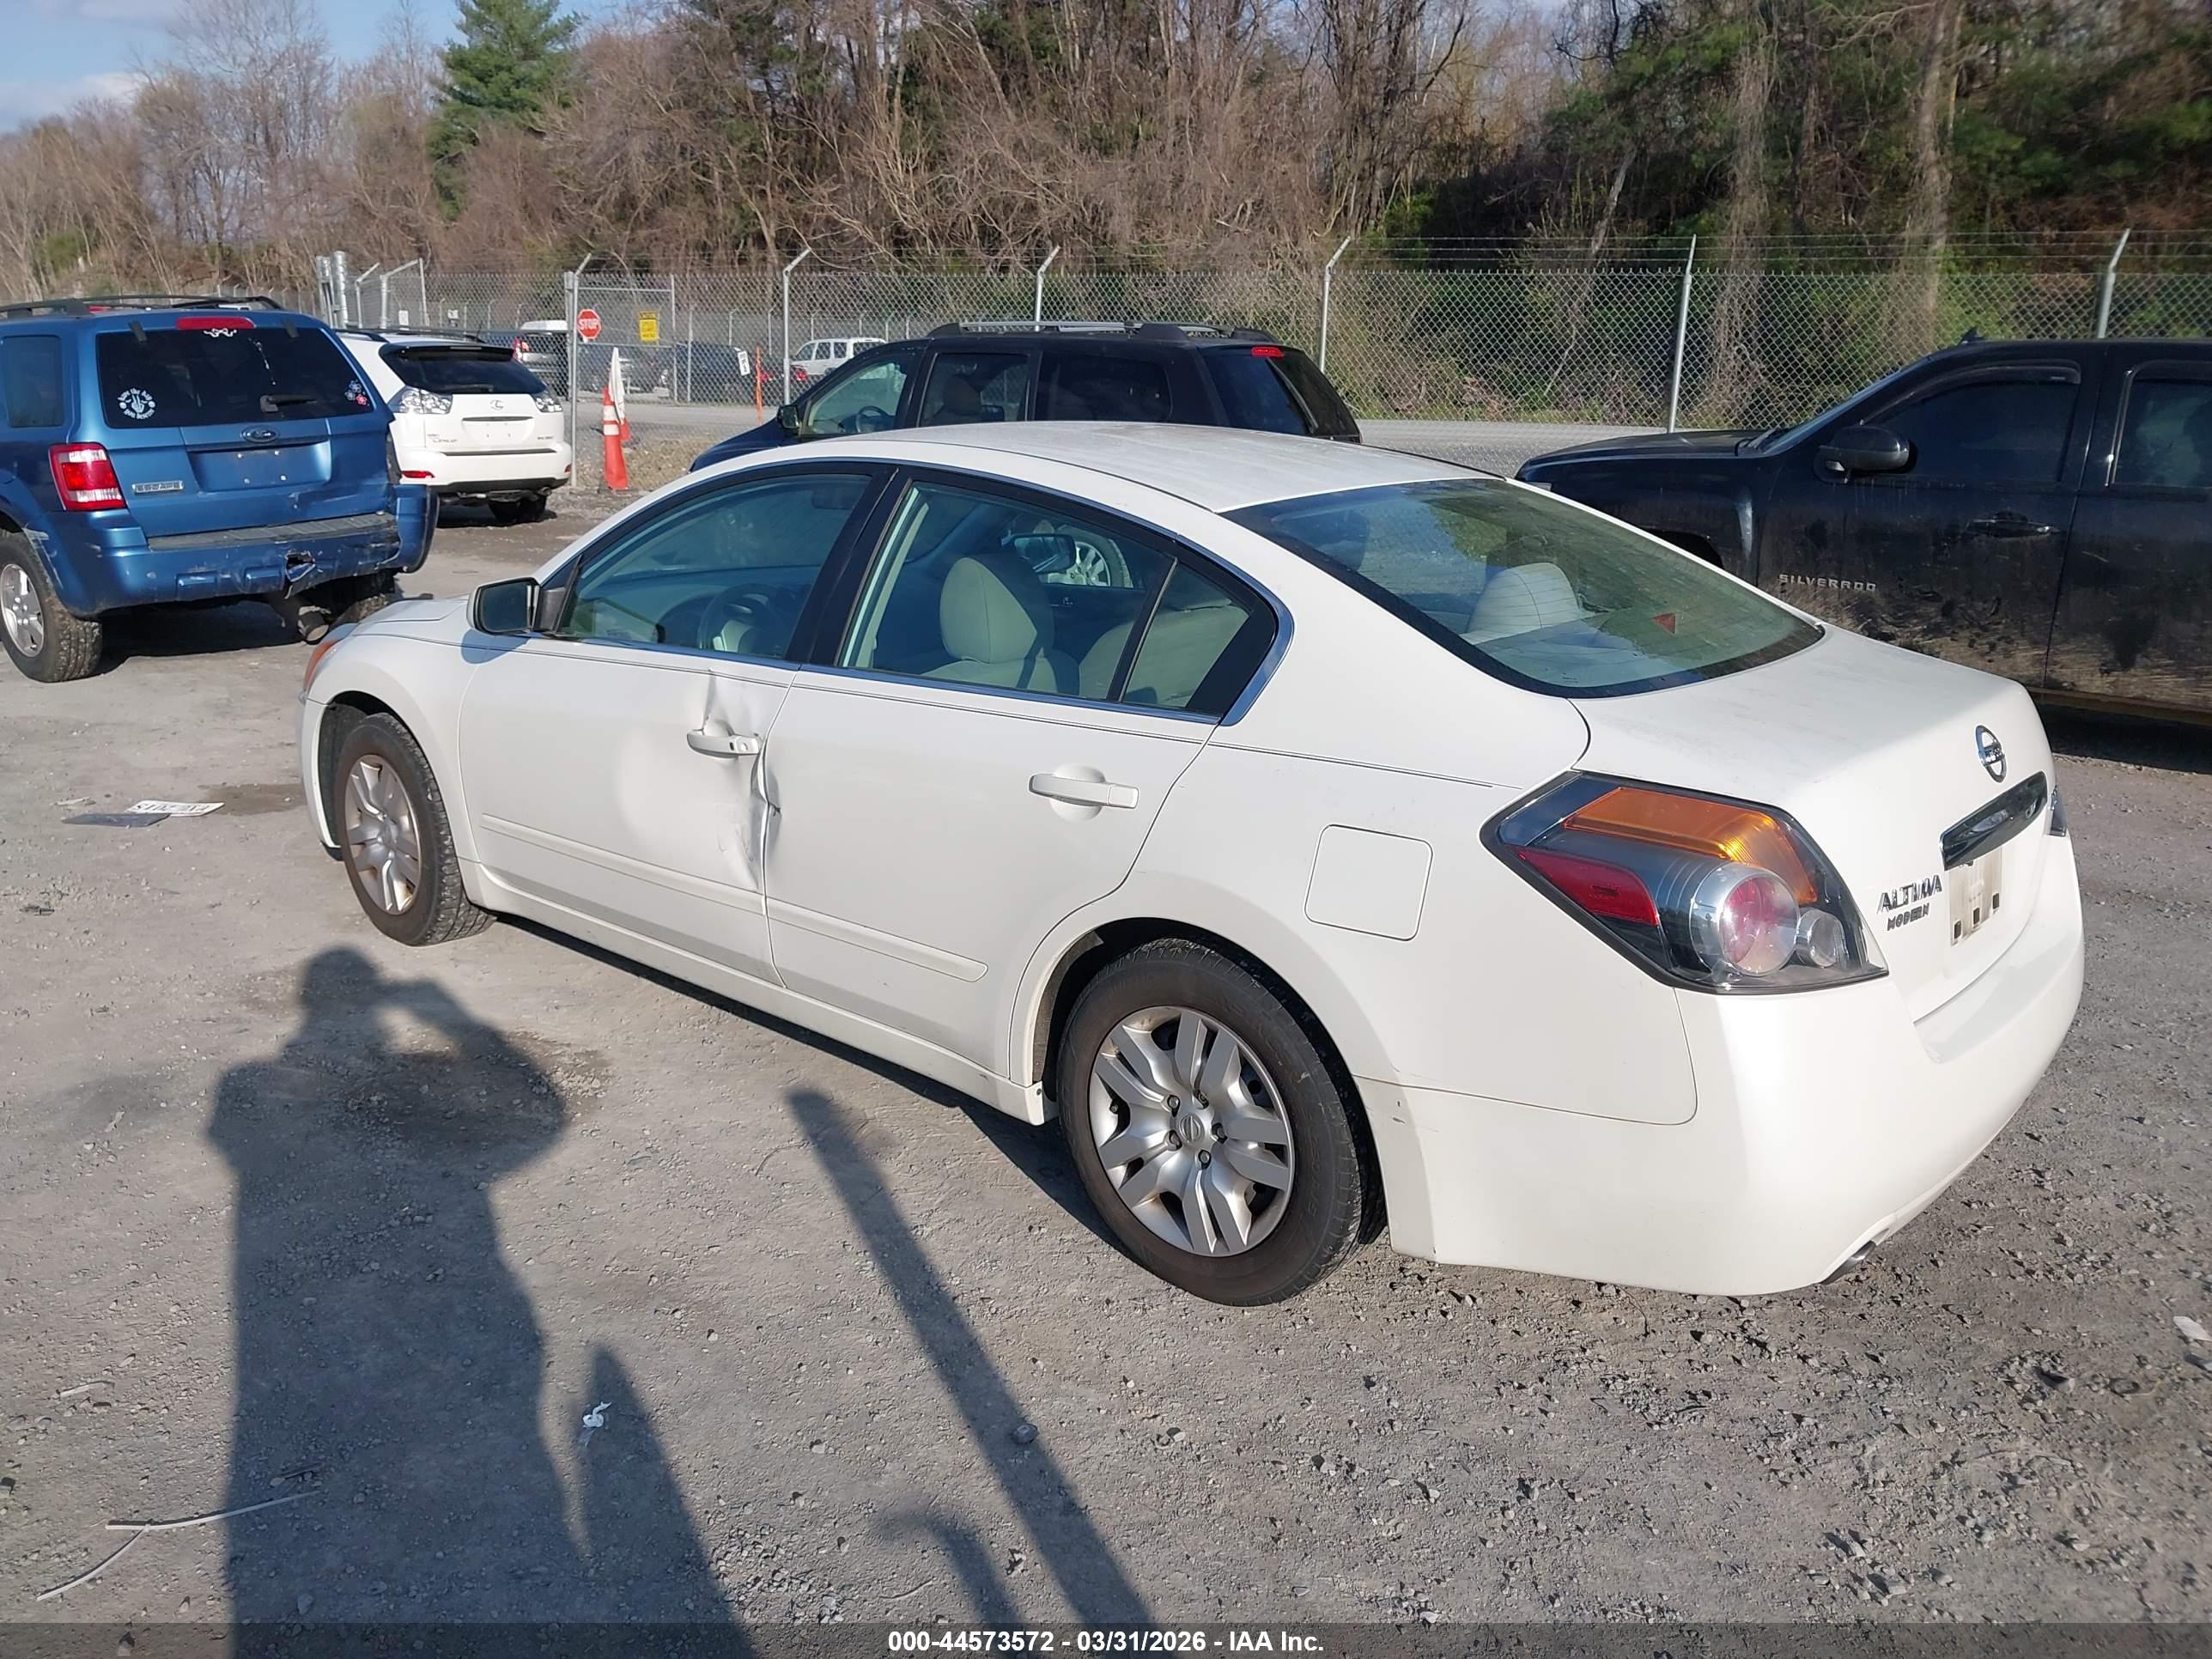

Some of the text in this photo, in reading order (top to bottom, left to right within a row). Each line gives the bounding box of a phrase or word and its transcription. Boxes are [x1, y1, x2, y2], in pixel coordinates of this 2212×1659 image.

[578, 319, 599, 330] STOP
[1778, 574, 1876, 592] SILVERADO
[1876, 874, 1942, 914] ALTIMA
[1887, 902, 1929, 931] MODERN
